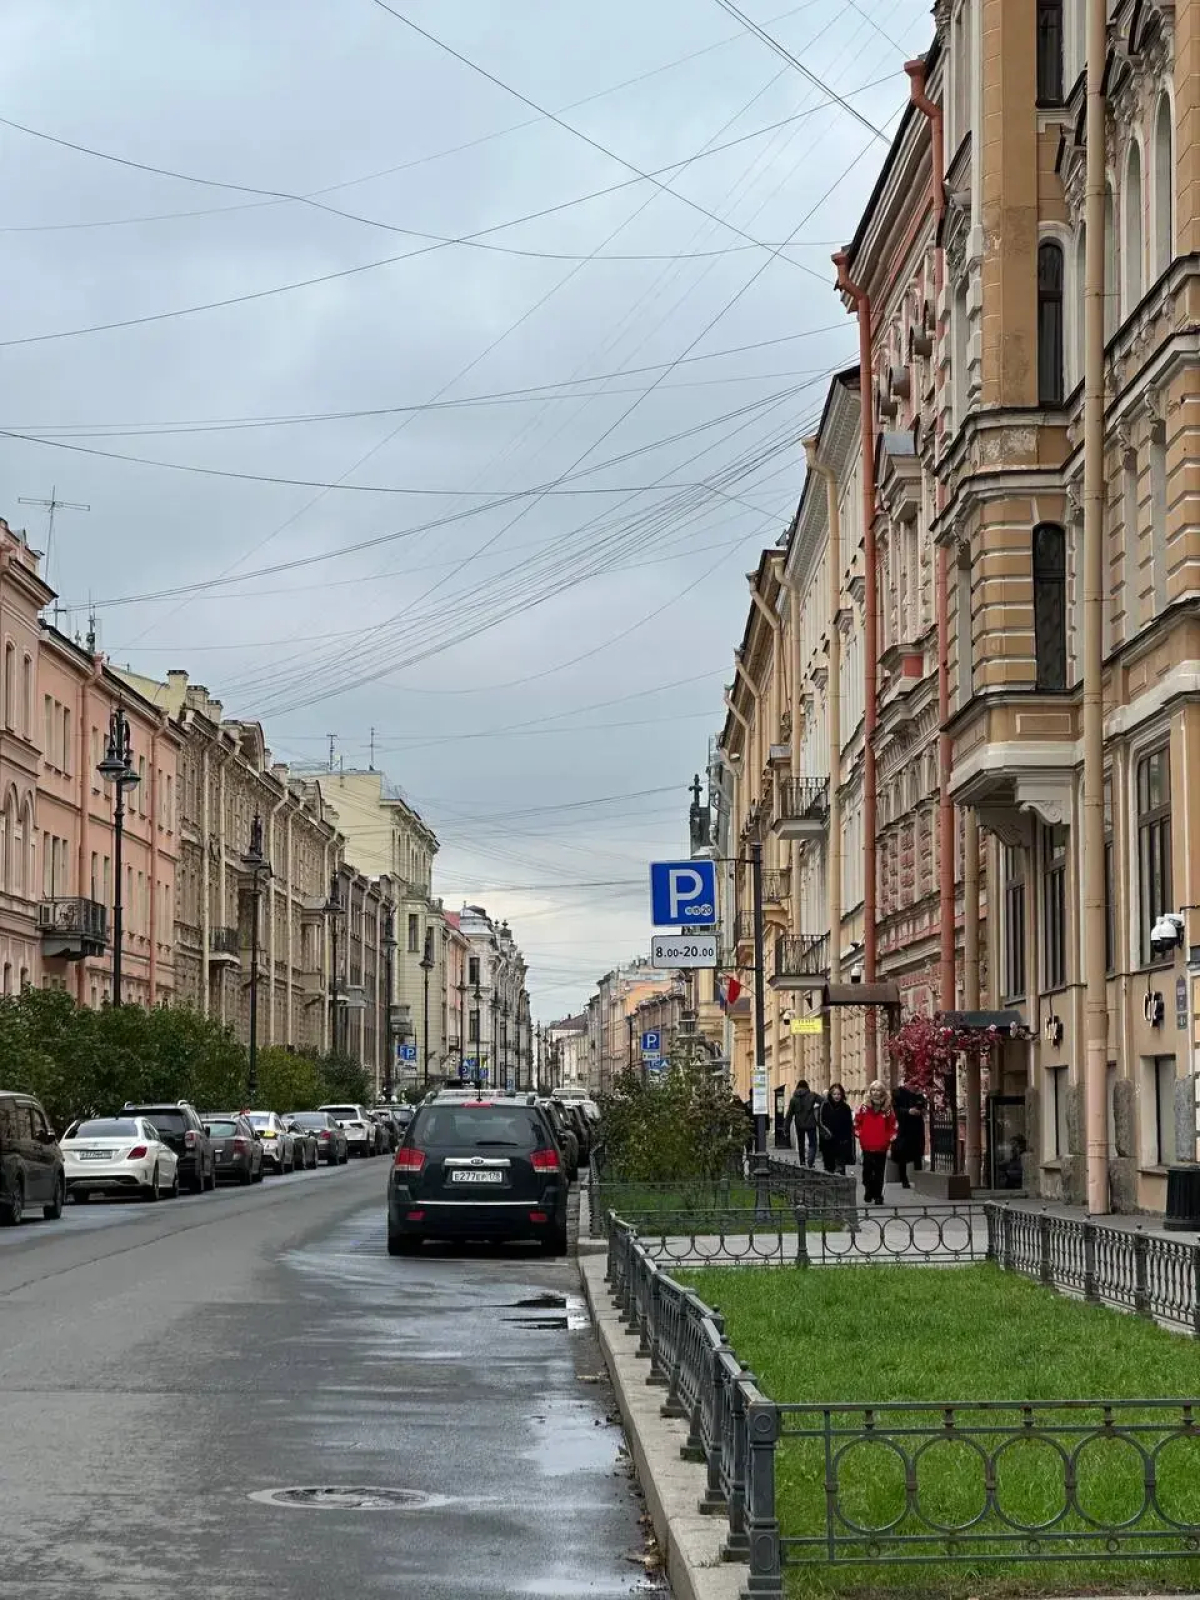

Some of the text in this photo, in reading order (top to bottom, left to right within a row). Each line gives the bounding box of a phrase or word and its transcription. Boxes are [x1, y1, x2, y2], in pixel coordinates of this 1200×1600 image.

[669, 869, 704, 919] P
[655, 946, 714, 958] 8.00-20.00
[647, 1034, 657, 1048] P
